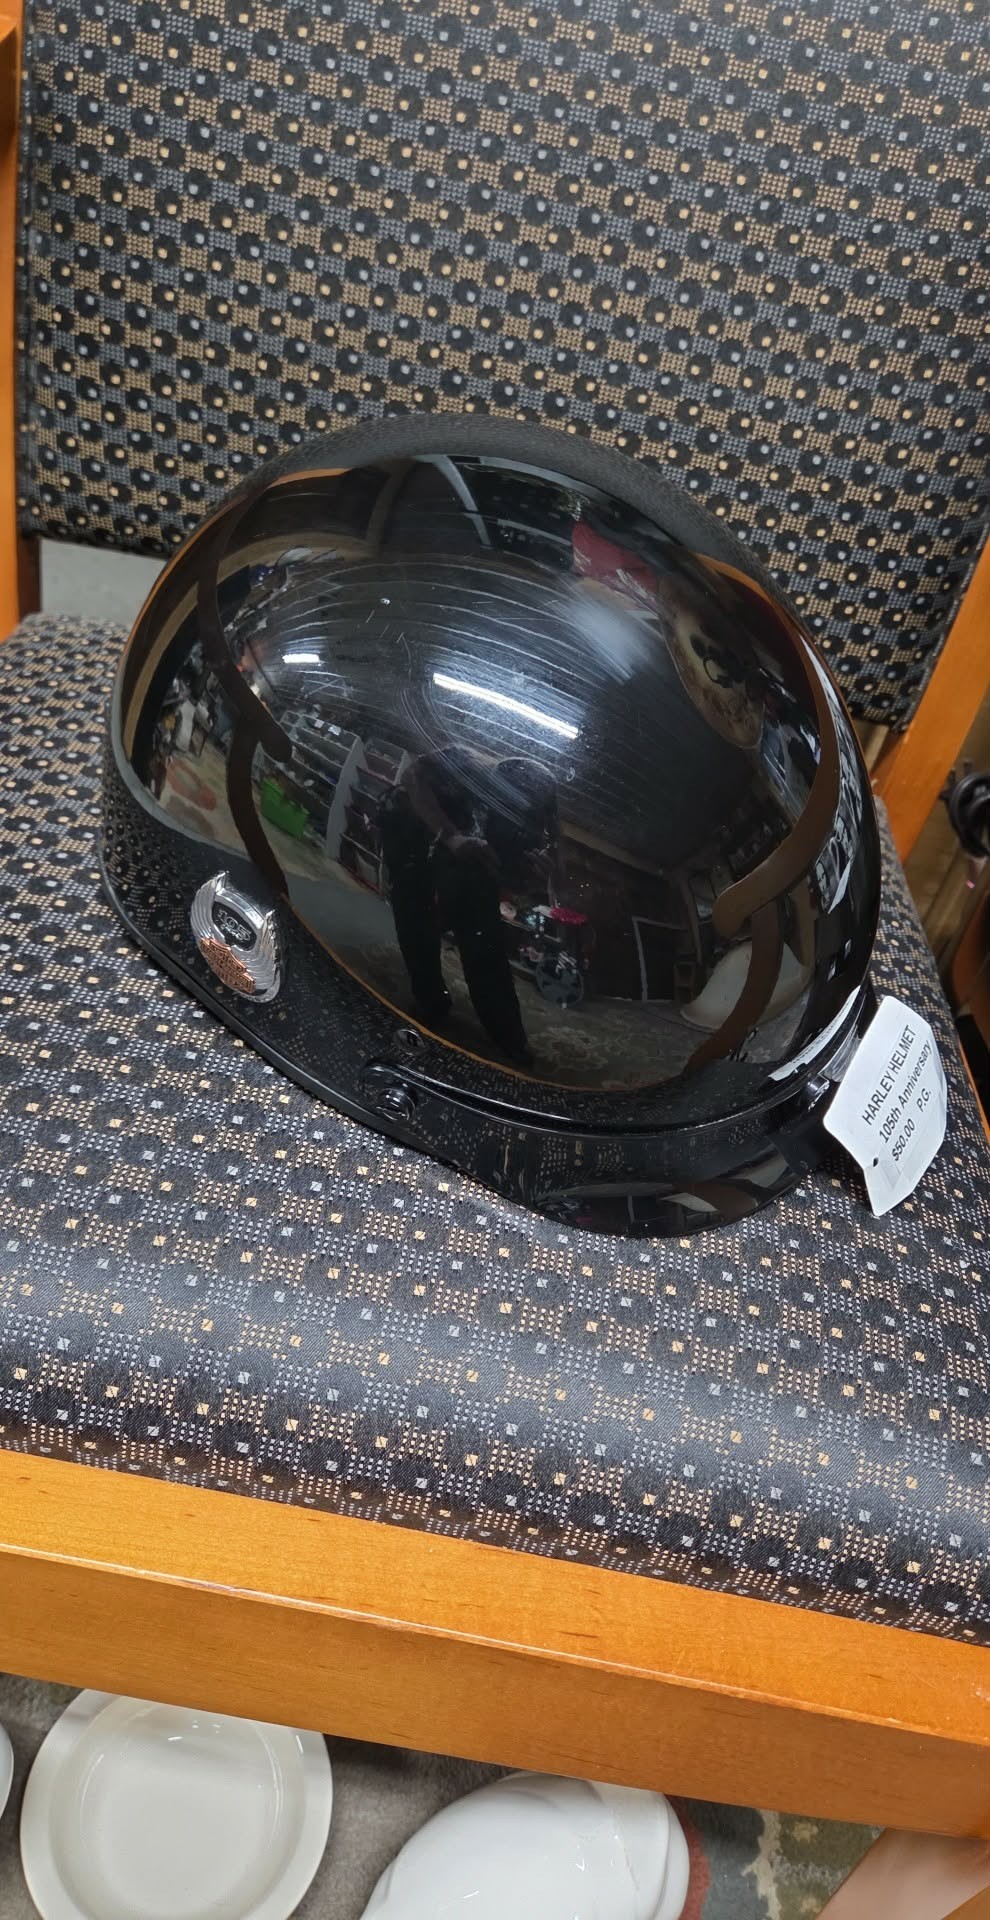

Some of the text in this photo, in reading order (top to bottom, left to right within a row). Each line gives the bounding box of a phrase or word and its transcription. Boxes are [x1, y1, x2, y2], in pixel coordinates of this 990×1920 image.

[861, 1024, 916, 1126] HARLEY HELMET
[879, 1039, 932, 1143] 105th Anniversary
[891, 1087, 932, 1162] $50.00 P.G.
